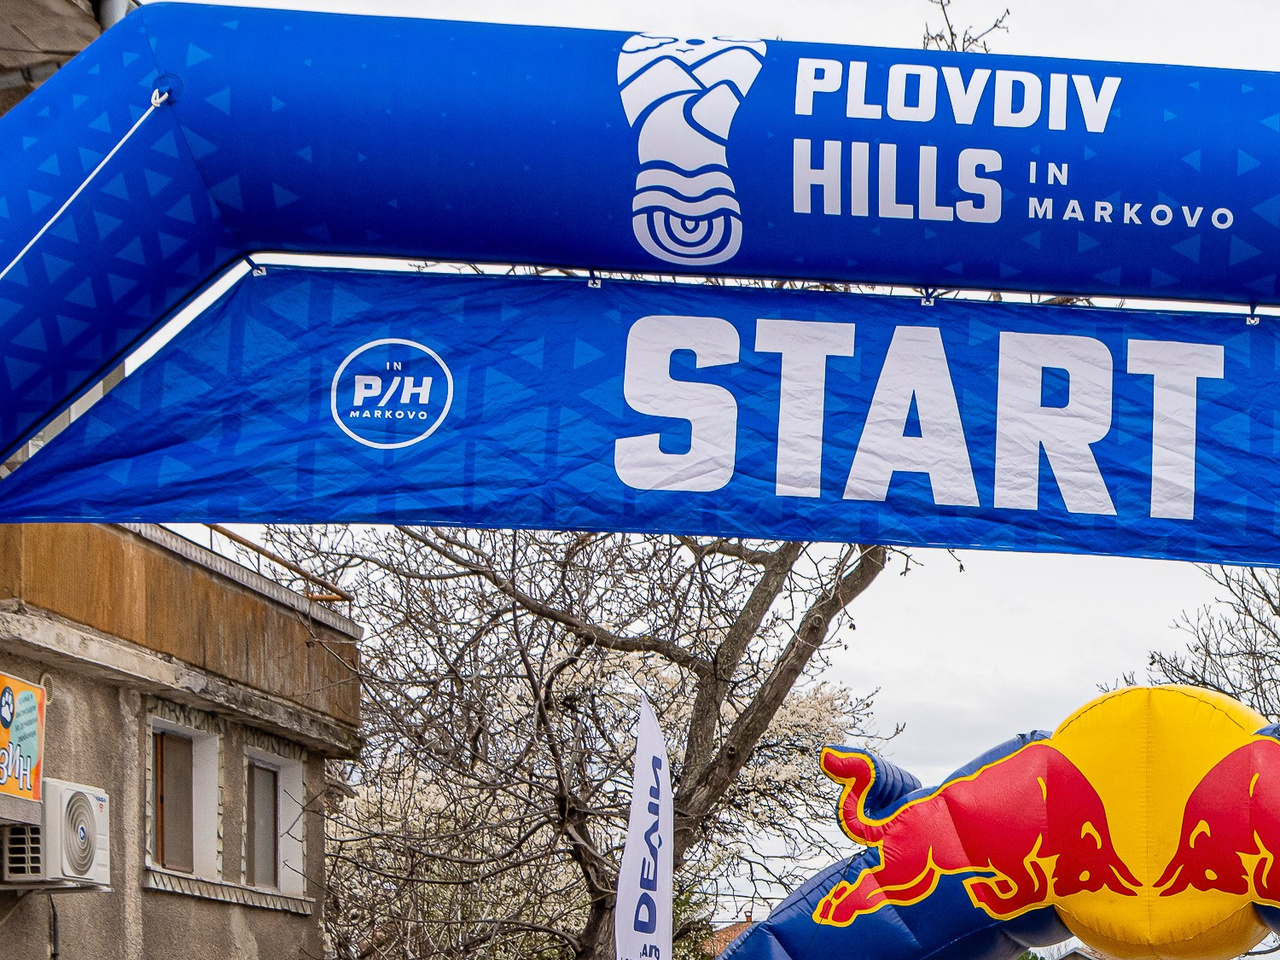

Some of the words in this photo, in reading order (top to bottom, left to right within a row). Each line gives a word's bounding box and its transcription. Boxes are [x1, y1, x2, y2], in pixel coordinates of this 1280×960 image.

[794, 58, 1122, 133] PLOVDIV
[793, 138, 1003, 223] HILLS
[1029, 161, 1069, 186] IN
[1028, 197, 1234, 230] MARKOVO
[386, 362, 401, 370] IN
[353, 375, 433, 406] P/H
[349, 410, 428, 420] MARKOVO
[614, 315, 1224, 520] START
